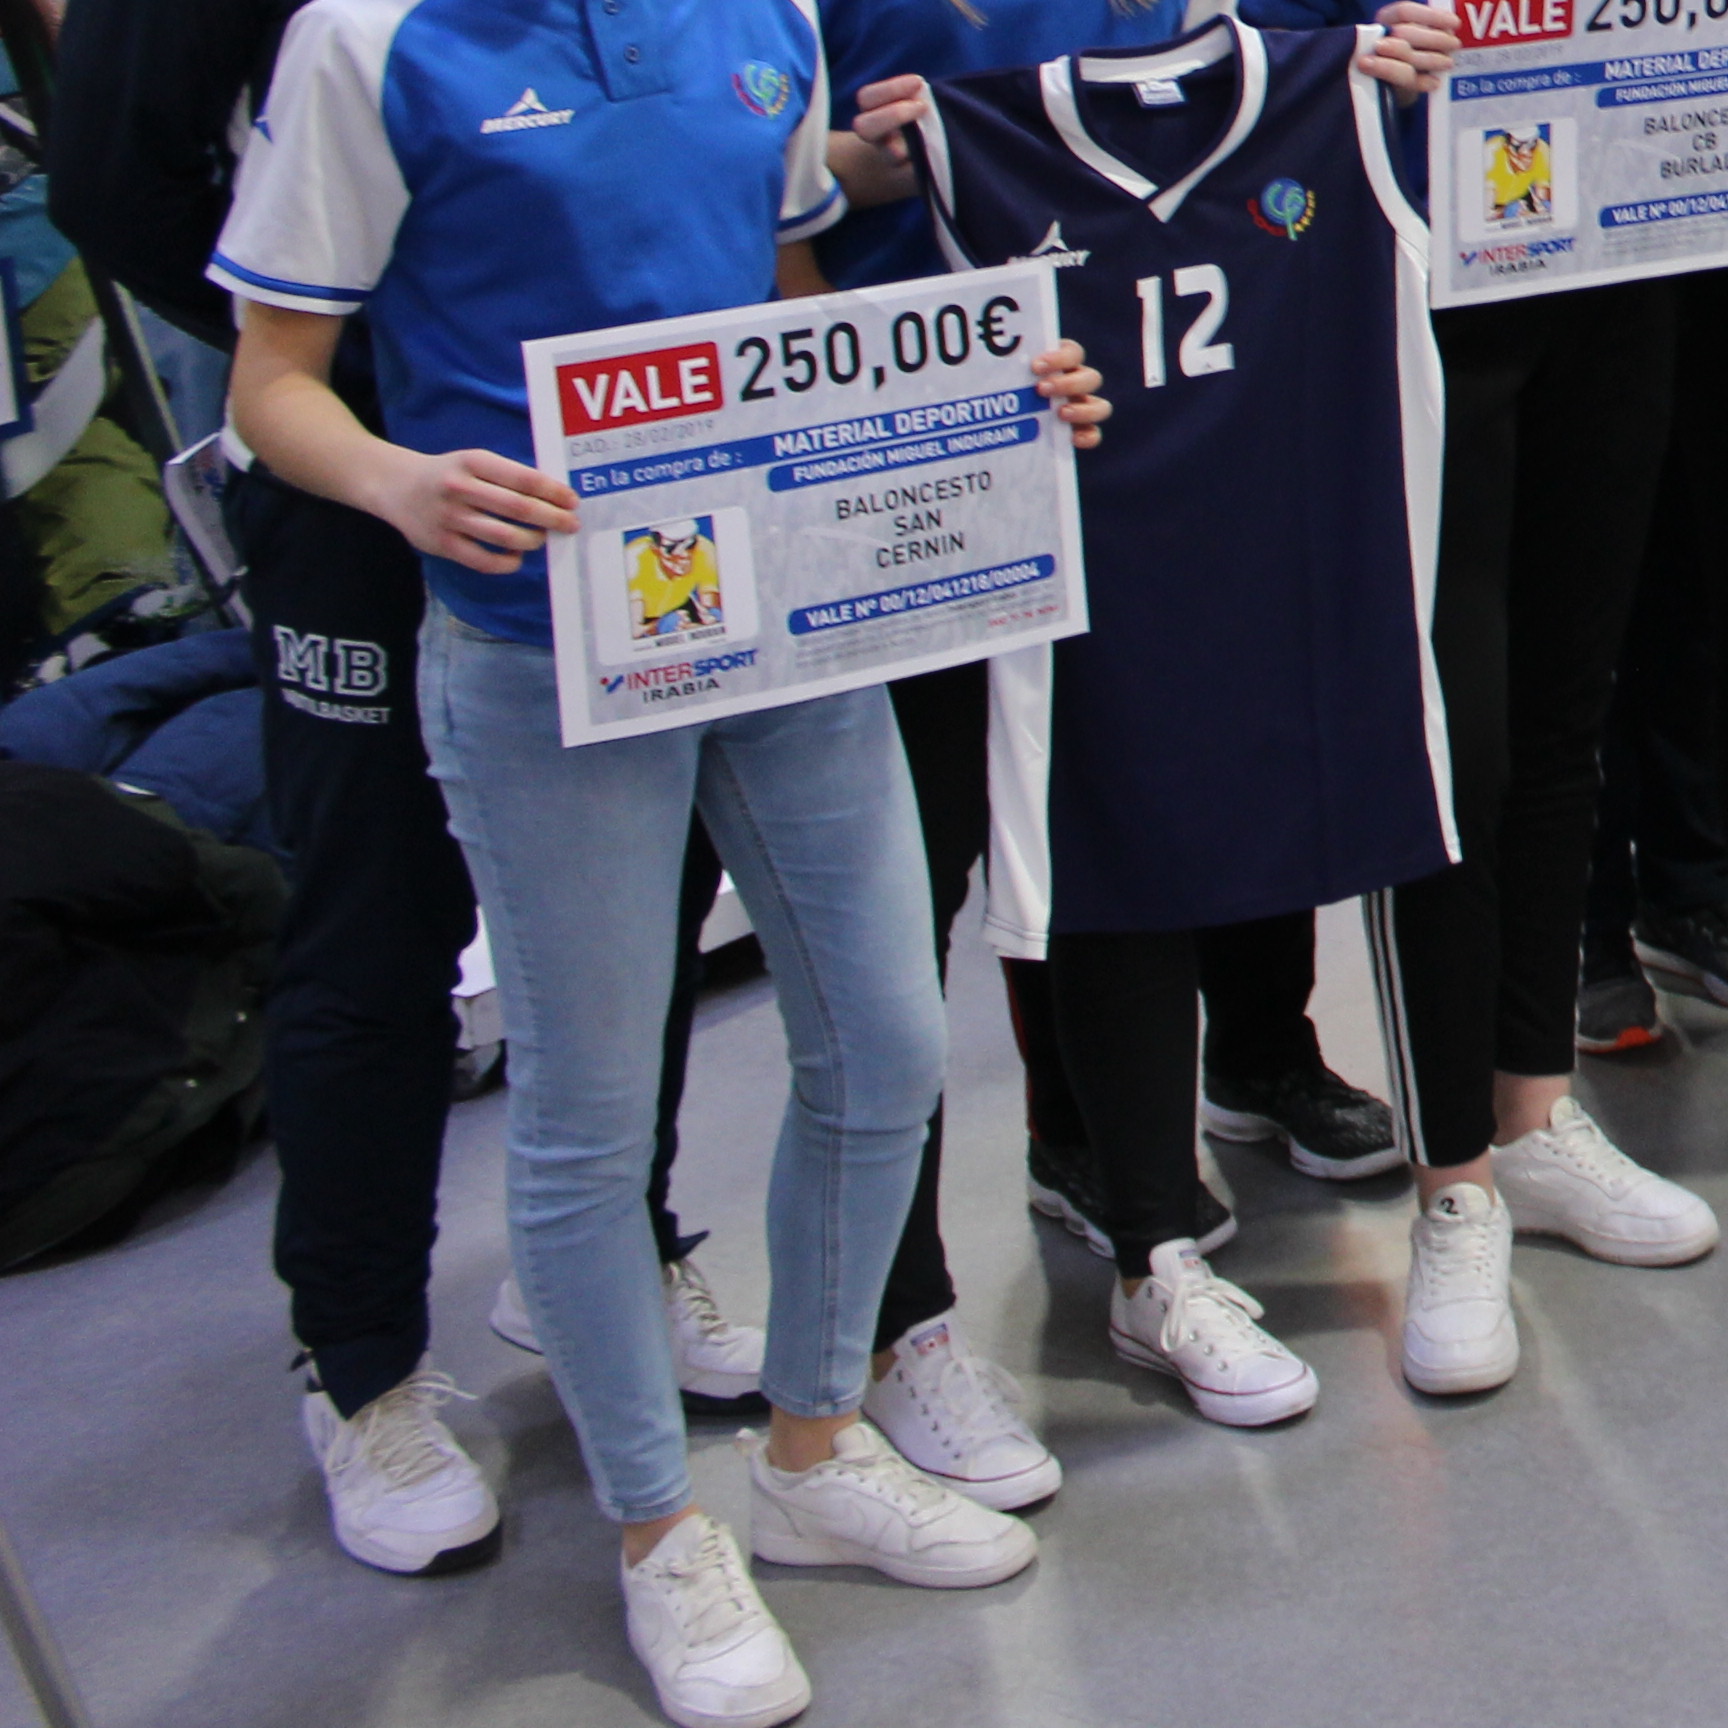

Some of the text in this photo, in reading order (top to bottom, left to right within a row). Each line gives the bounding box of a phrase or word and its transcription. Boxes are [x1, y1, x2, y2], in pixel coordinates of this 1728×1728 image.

[1496, 72, 1550, 94] compra
[1604, 51, 1696, 81] MATERIAL
[480, 109, 576, 134] MERCURY
[1691, 132, 1718, 152] CB
[1613, 206, 1649, 224] VALE
[1478, 237, 1575, 265] INTERSPORT
[1136, 263, 1236, 389] 12
[572, 295, 1022, 421] VALE 250,00€
[581, 392, 1020, 492] En la compra de MATERIAL DEPORTIVO
[792, 425, 1020, 483] FUNDACIÓN MIGUEL INDURAIN
[836, 470, 993, 520] BALONCESTO
[893, 508, 943, 537] SAN
[876, 531, 966, 569] CERNIN
[806, 604, 854, 628] VALE
[271, 624, 388, 697] MB
[627, 648, 758, 691] INTERSPORT
[643, 677, 720, 703] IRABIA
